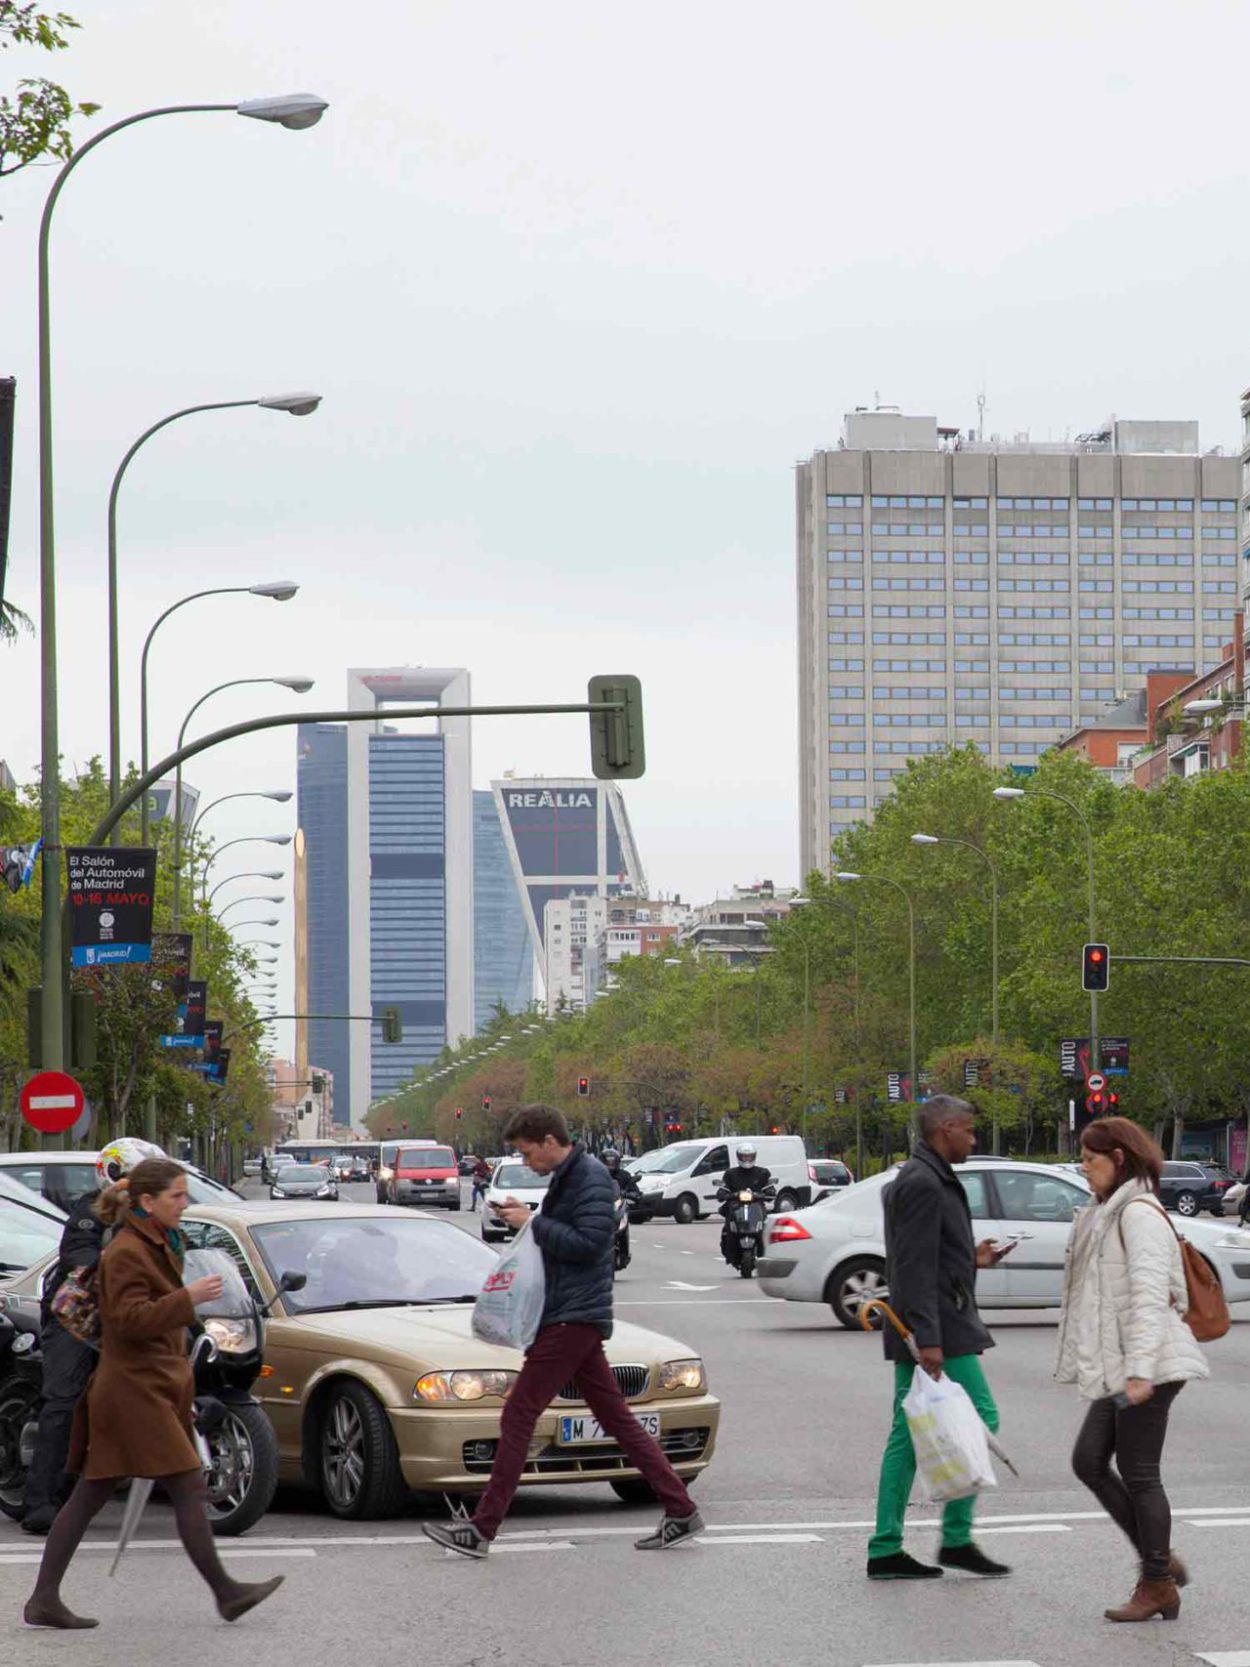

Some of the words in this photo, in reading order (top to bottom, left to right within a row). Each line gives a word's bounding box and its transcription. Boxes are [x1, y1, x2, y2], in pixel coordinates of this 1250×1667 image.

[509, 790, 592, 807] REALIA
[70, 856, 79, 866] El
[82, 856, 114, 866] Salón
[70, 868, 84, 878] del
[86, 867, 145, 878] Automóvil
[71, 880, 82, 889] de
[84, 879, 124, 889] Madrid
[106, 893, 150, 905] MAYO
[1061, 1041, 1076, 1072] AUTO
[888, 1073, 900, 1098] AUTO
[835, 1088, 845, 1103] AU
[573, 1420, 583, 1438] M
